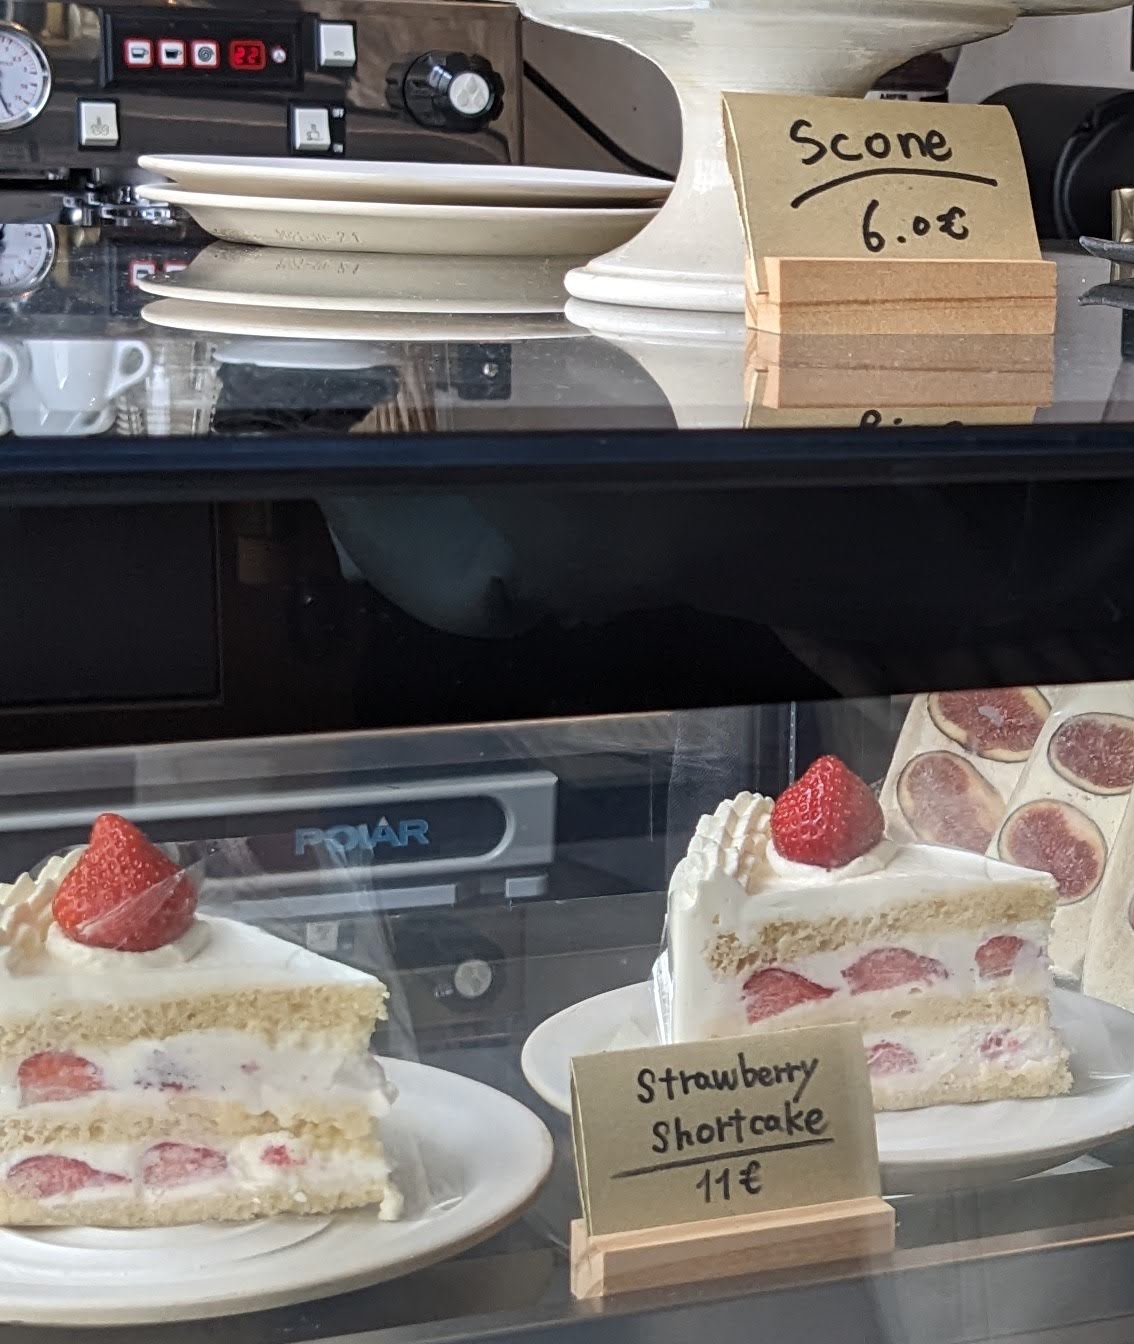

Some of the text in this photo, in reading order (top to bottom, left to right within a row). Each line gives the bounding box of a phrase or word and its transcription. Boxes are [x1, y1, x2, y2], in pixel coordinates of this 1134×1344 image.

[790, 118, 953, 166] Scone
[637, 1052, 820, 1104] Strawberry
[651, 1100, 828, 1154] Shortcake
